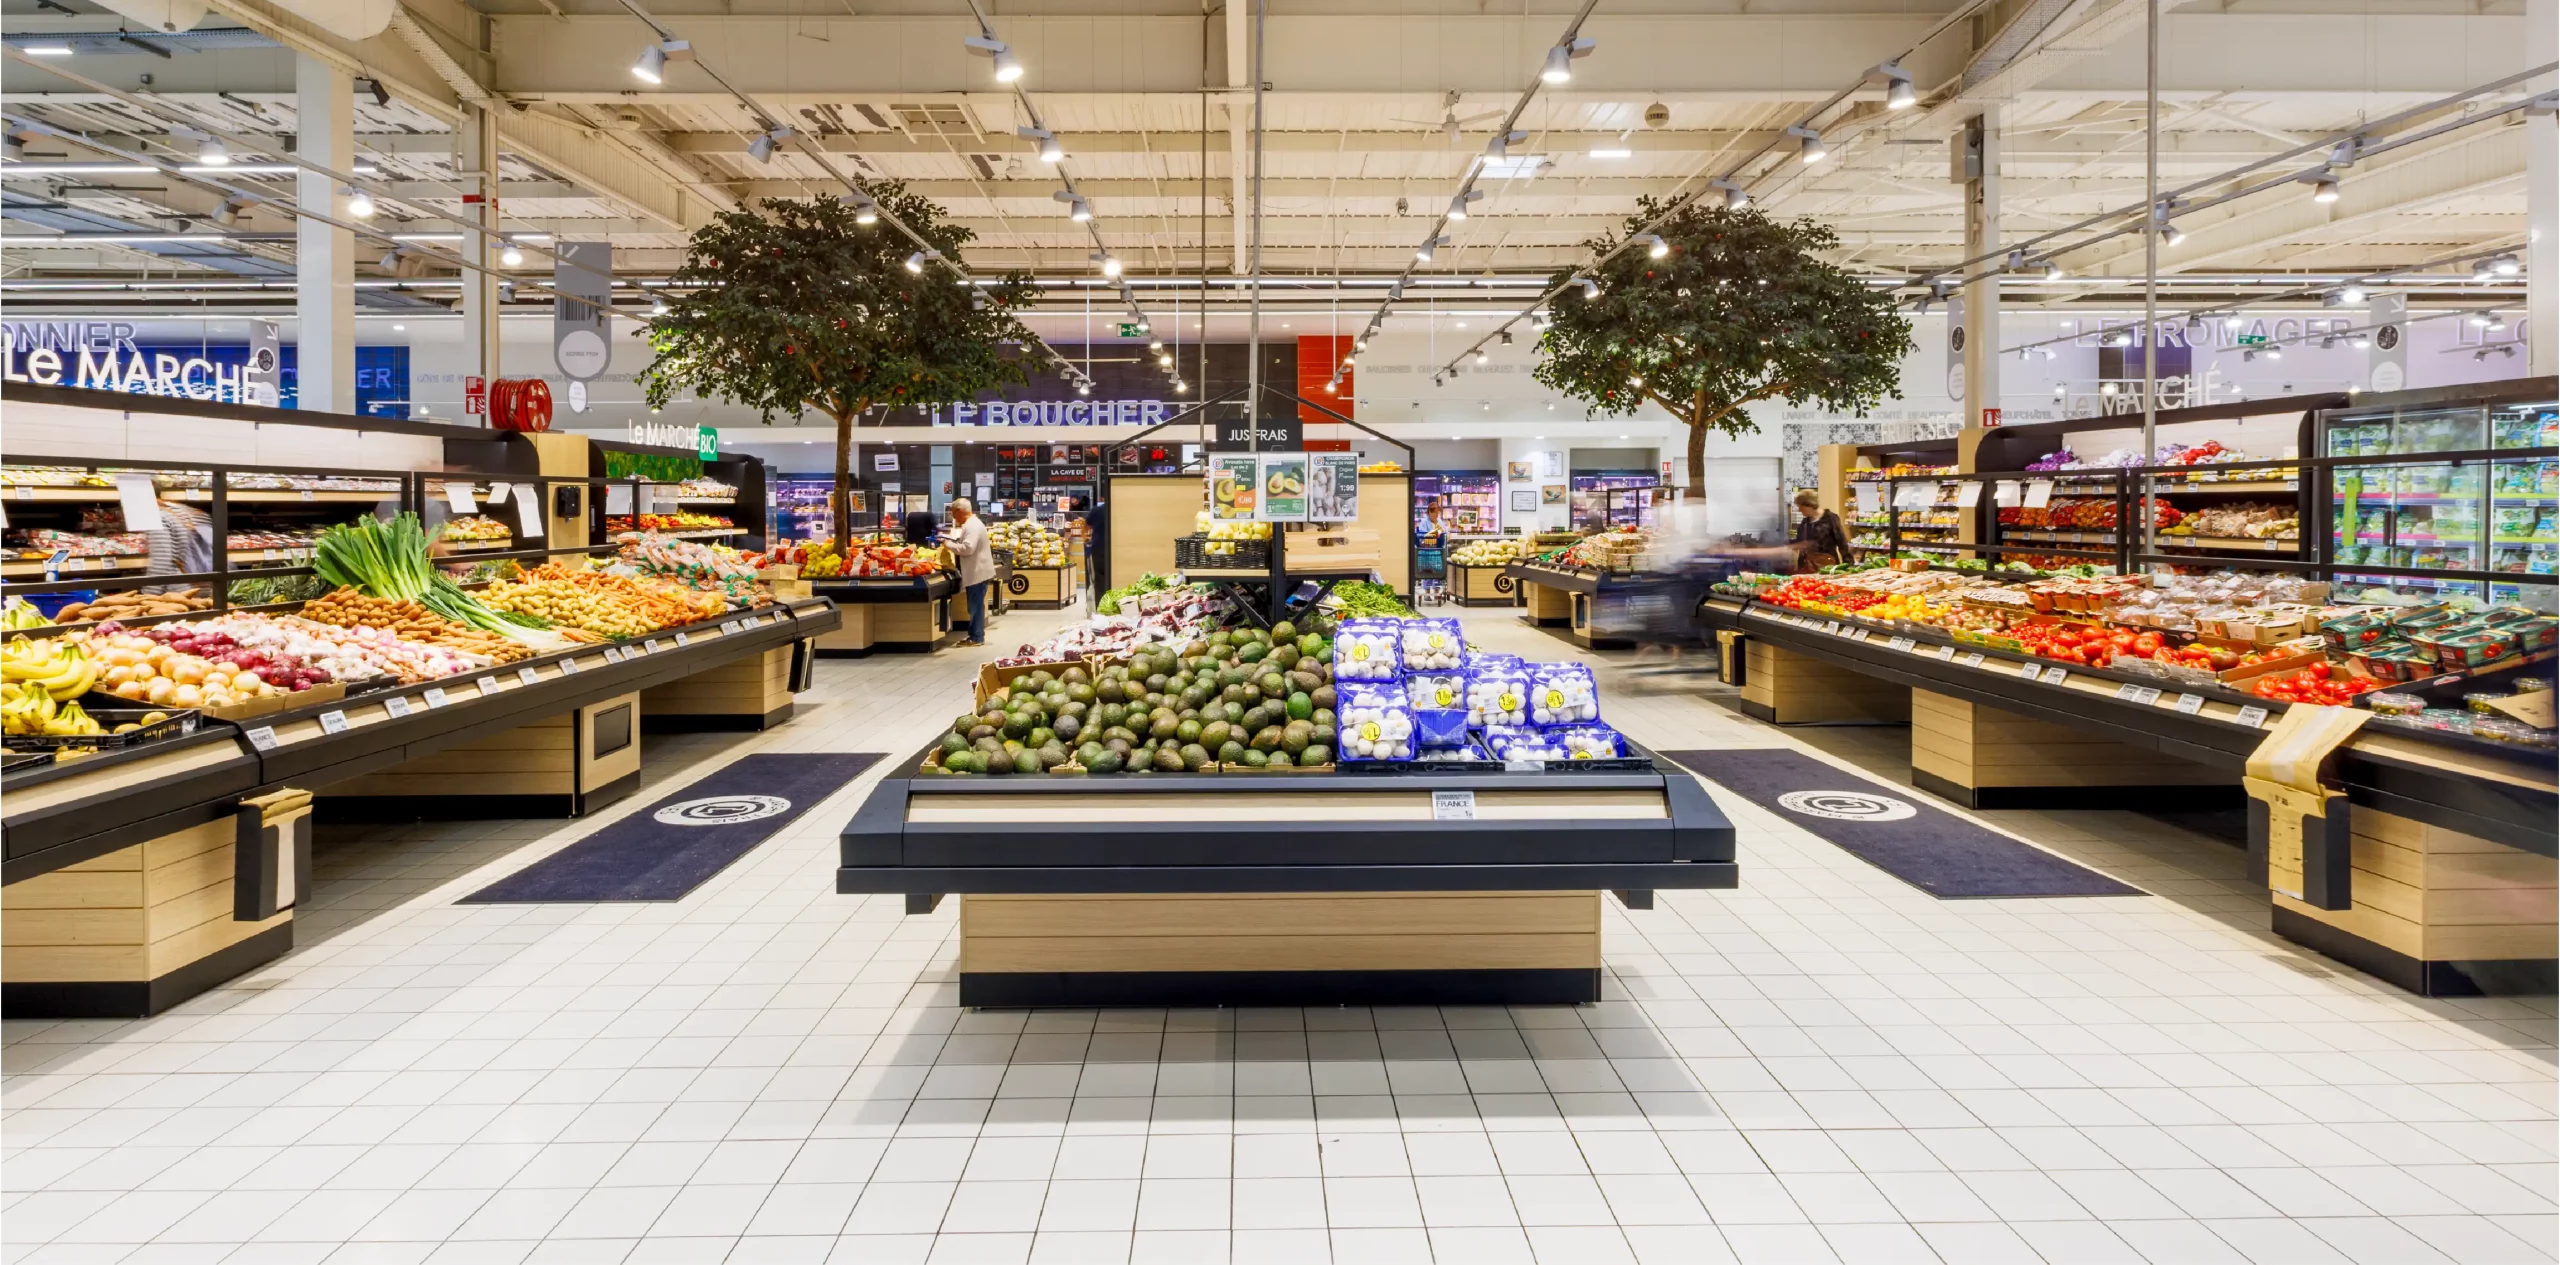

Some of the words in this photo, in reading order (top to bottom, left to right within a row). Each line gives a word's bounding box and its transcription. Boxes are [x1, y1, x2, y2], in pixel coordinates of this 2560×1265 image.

[4, 333, 62, 385] Le
[77, 343, 262, 406] MARCHÉ
[932, 401, 976, 427] LE
[987, 400, 1164, 427] BOUCHER
[628, 418, 644, 444] Le
[645, 422, 700, 450] MARCHÉ
[700, 434, 717, 454] BIO
[1228, 428, 1250, 442] JUS
[1436, 800, 1470, 808] FRANCE
